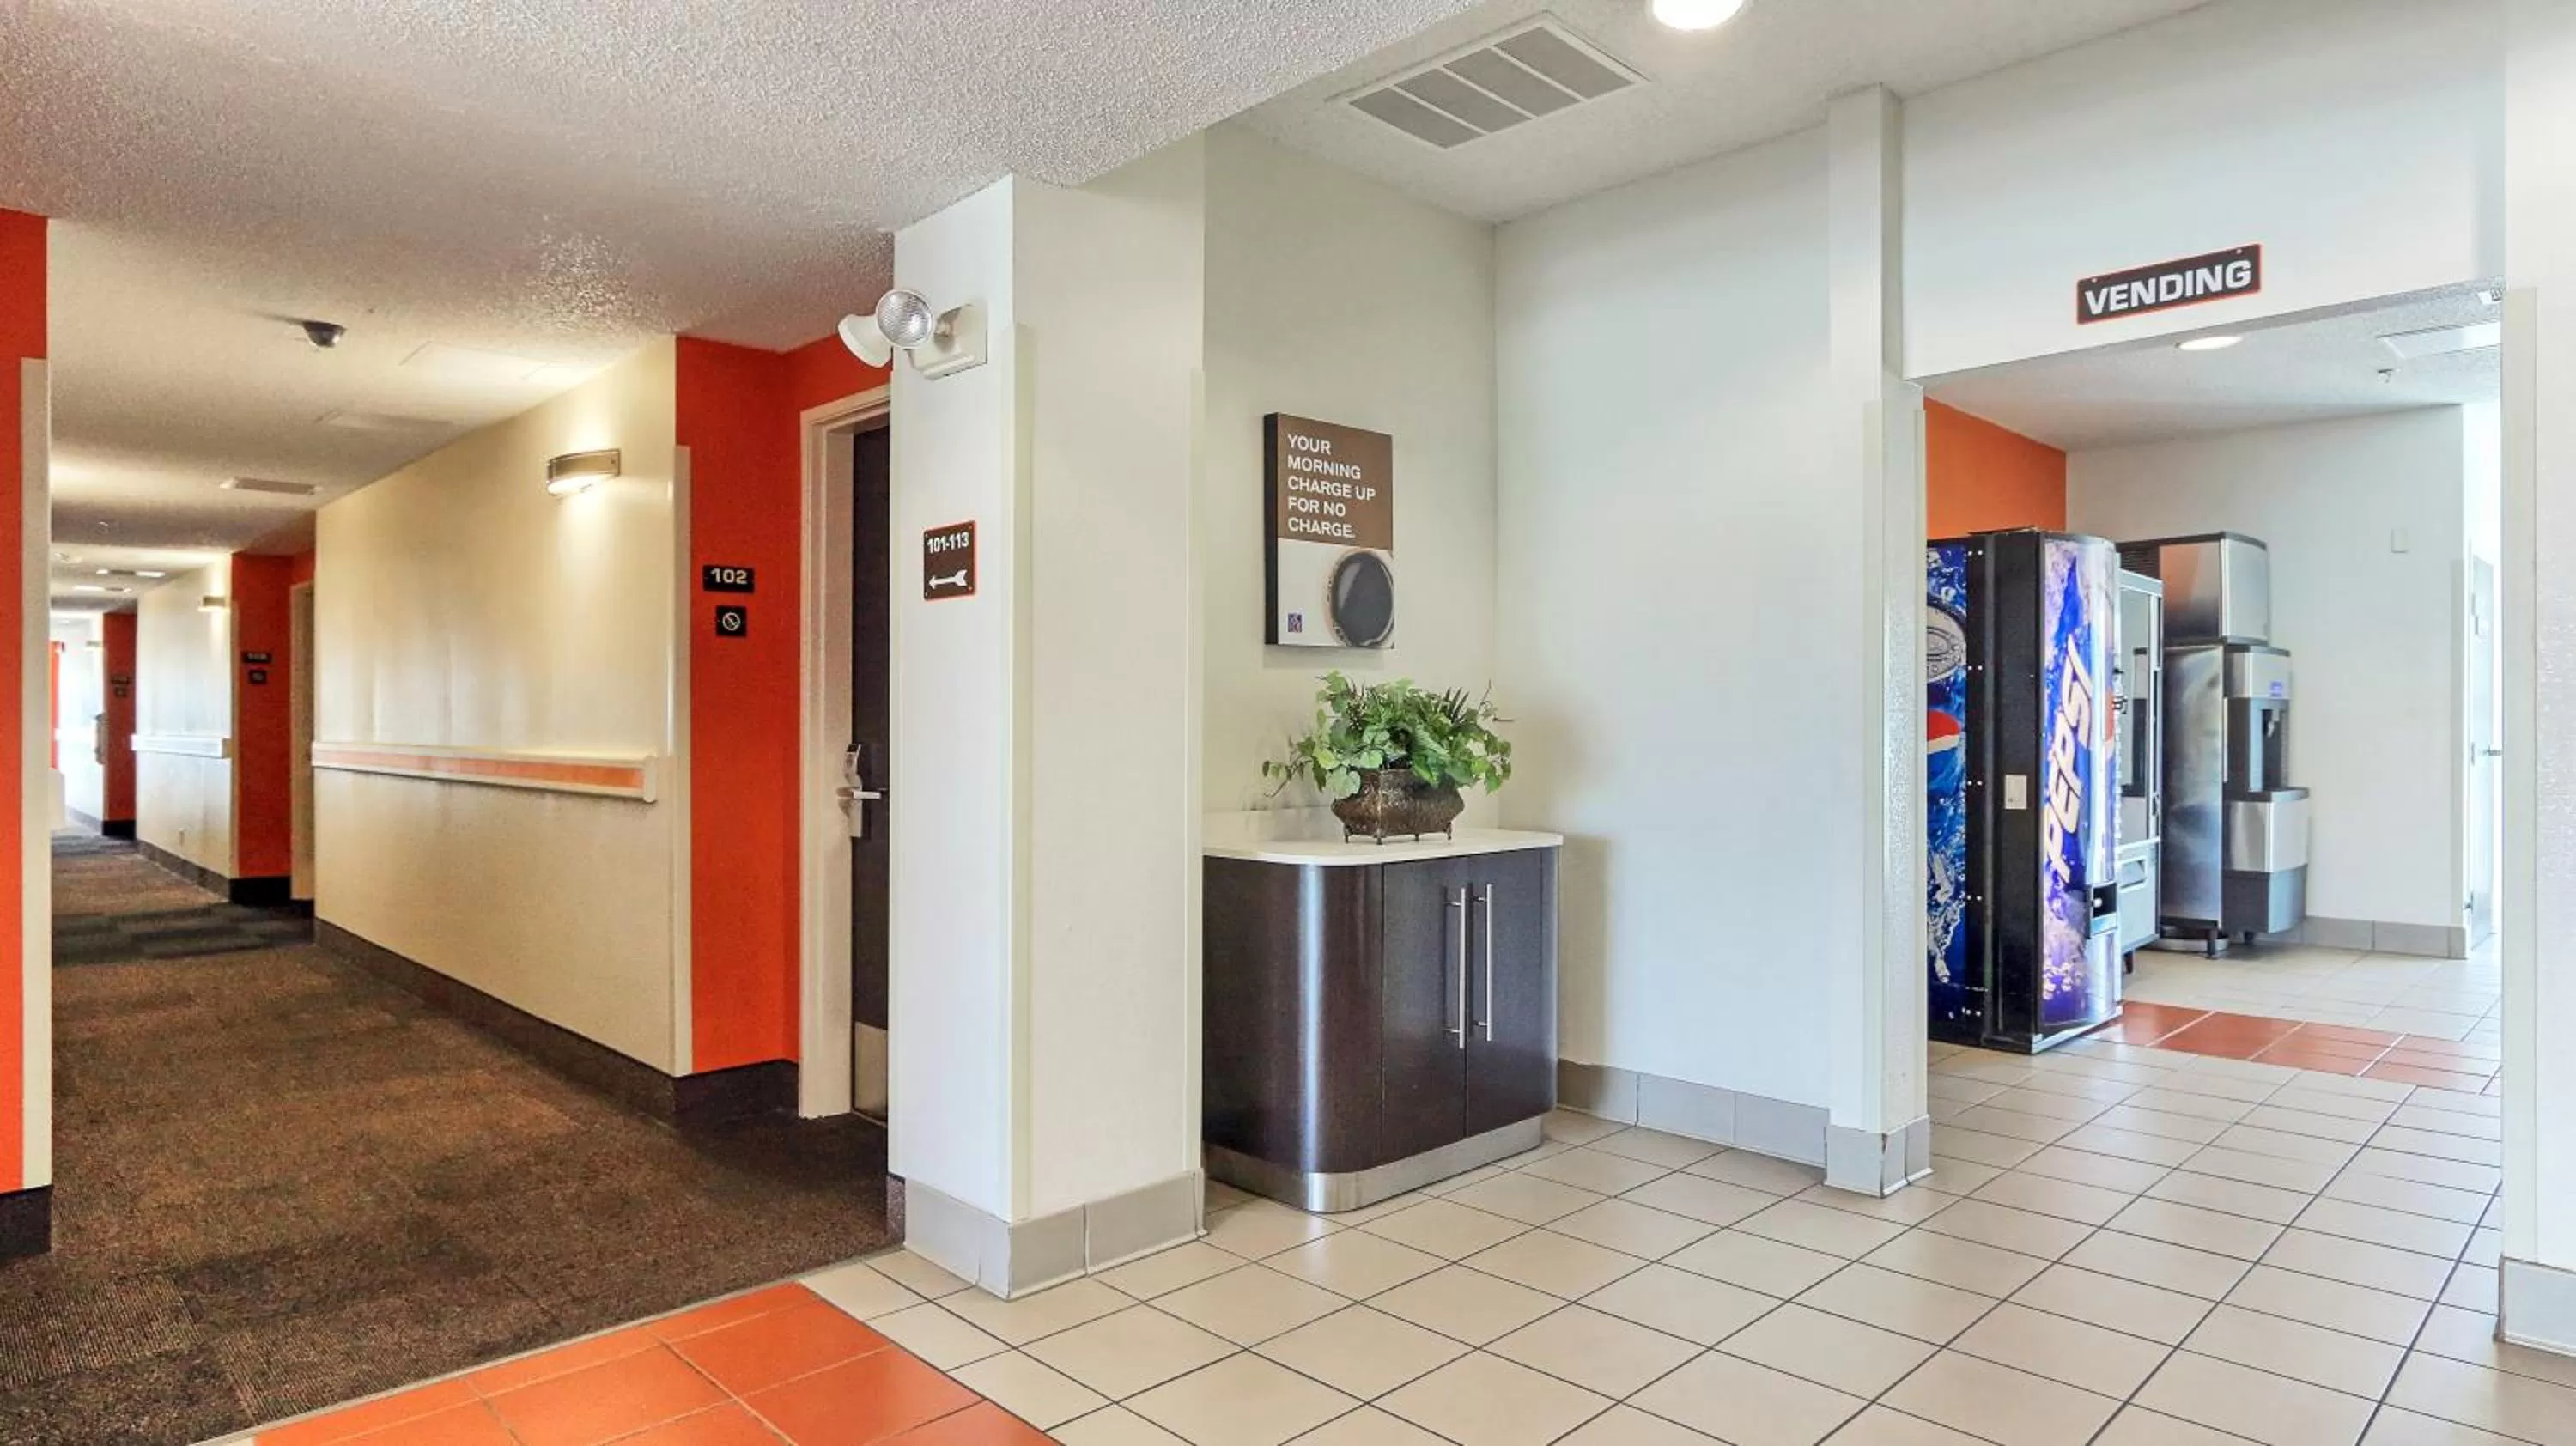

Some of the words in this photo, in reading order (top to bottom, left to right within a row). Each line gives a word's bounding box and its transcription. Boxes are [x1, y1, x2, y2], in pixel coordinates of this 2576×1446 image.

[2085, 260, 2252, 315] VENDING
[1287, 434, 1331, 454] YOUR
[1287, 454, 1361, 480] MORNING
[1287, 476, 1352, 498] CHARGE
[1356, 487, 1376, 501] UP
[1288, 496, 1320, 513] FOR
[1323, 501, 1346, 517] NO
[1287, 517, 1356, 538] CHARGE.
[927, 532, 969, 554] 101-113
[711, 568, 747, 585] 102
[2045, 633, 2092, 884] PEPSI
